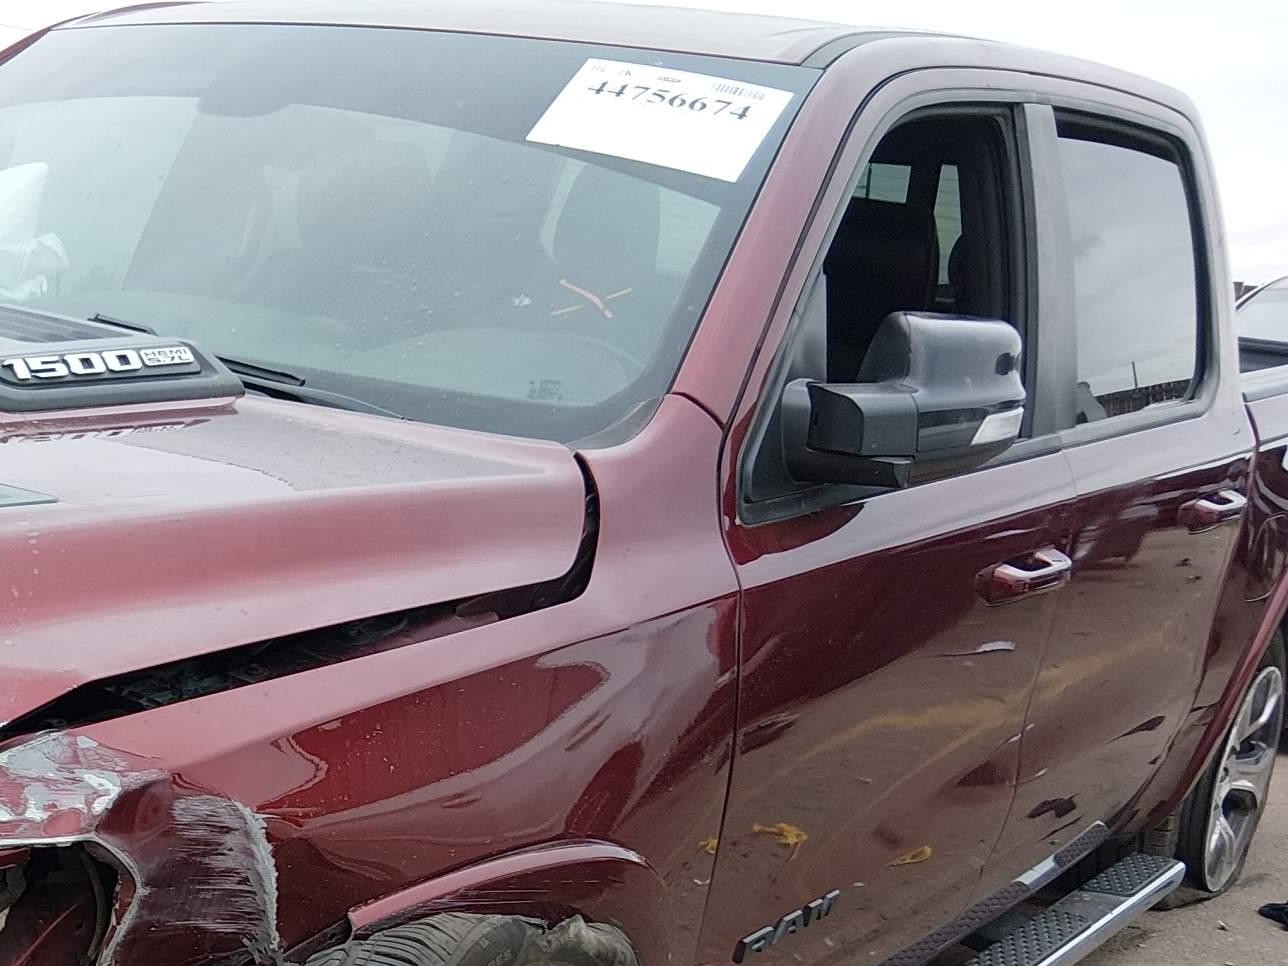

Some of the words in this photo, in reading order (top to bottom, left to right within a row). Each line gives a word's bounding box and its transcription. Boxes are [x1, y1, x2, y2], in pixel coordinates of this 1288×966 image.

[587, 80, 752, 120] 44756674
[1, 349, 143, 381] 1500
[143, 348, 188, 358] HEMI
[730, 888, 841, 965] RAM
